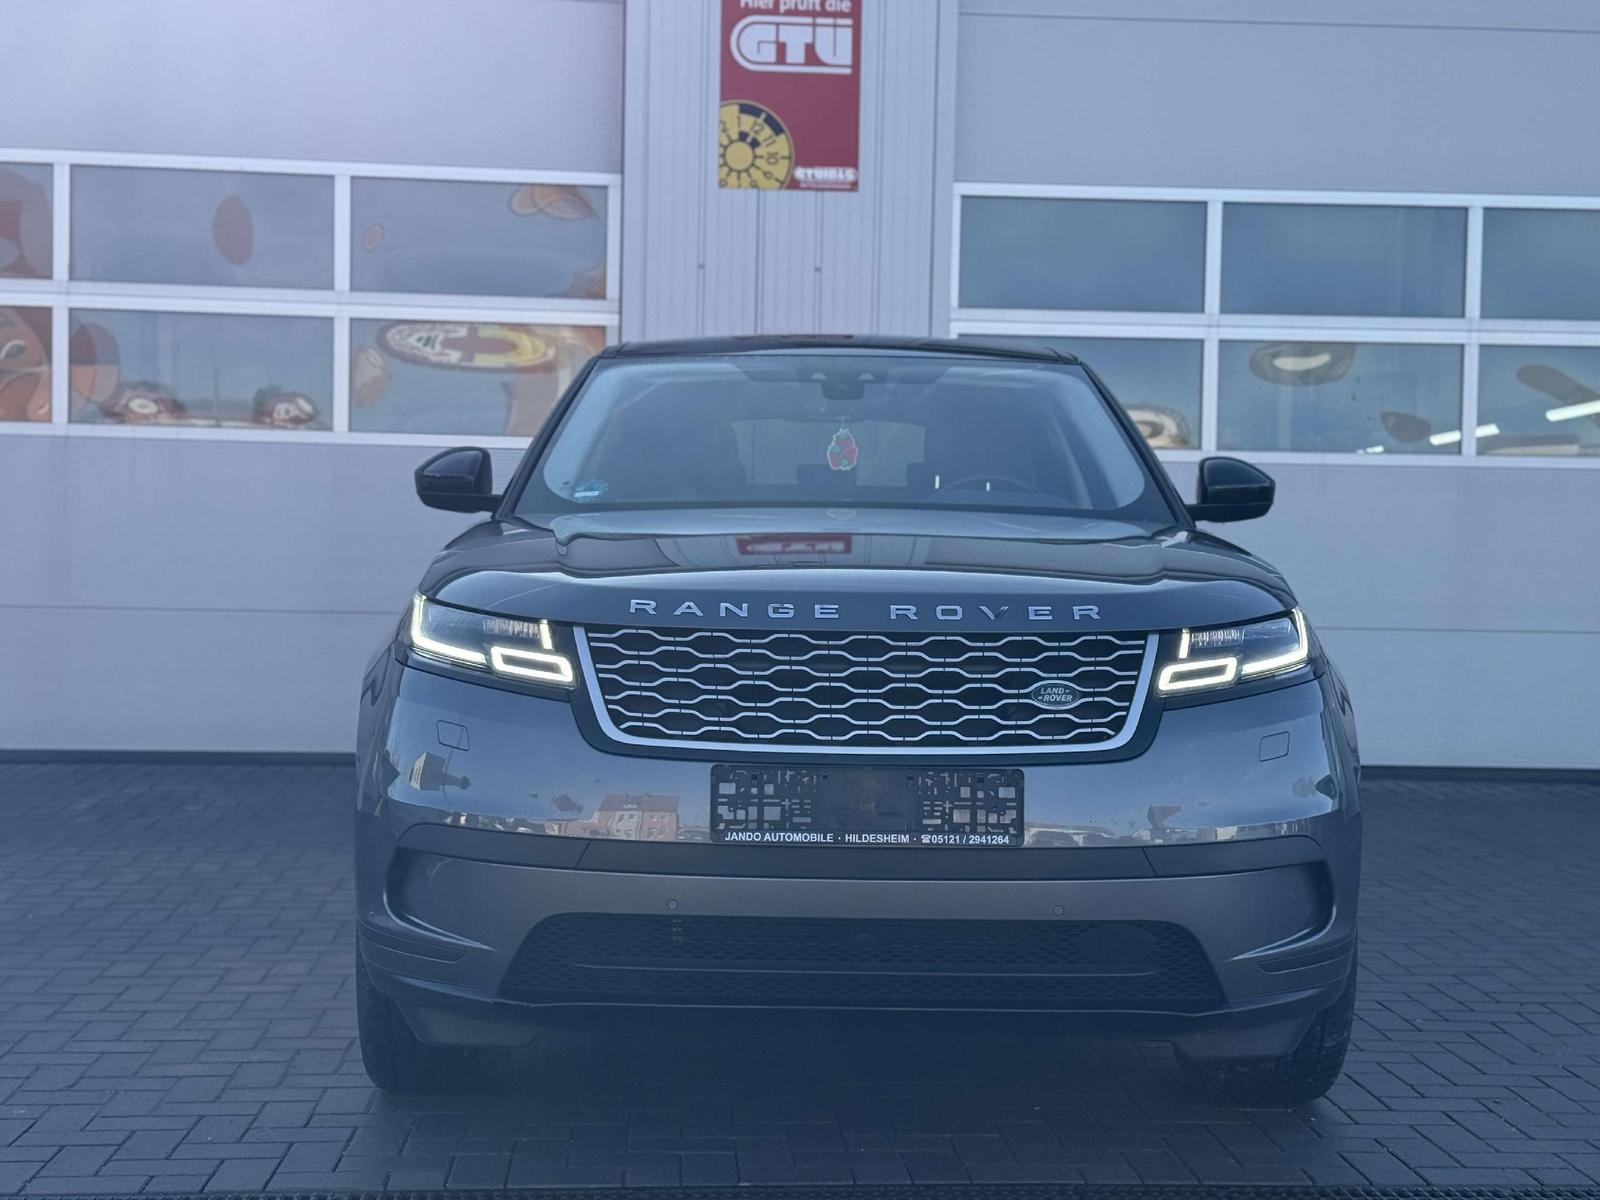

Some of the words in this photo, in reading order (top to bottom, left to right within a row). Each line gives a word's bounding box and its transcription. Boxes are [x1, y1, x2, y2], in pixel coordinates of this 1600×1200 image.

[825, 0, 852, 12] die
[732, 16, 852, 73] GTÜ
[629, 599, 840, 619] RANGE
[889, 605, 1101, 620] ROVER
[1040, 687, 1065, 695] LAND
[1043, 694, 1073, 702] ROVER
[724, 832, 762, 842] JANDO
[763, 833, 834, 843] AUTOMOBILE
[845, 834, 910, 843] HILDESHEIM
[931, 835, 960, 845] 05121
[968, 835, 1010, 845] 2941264
